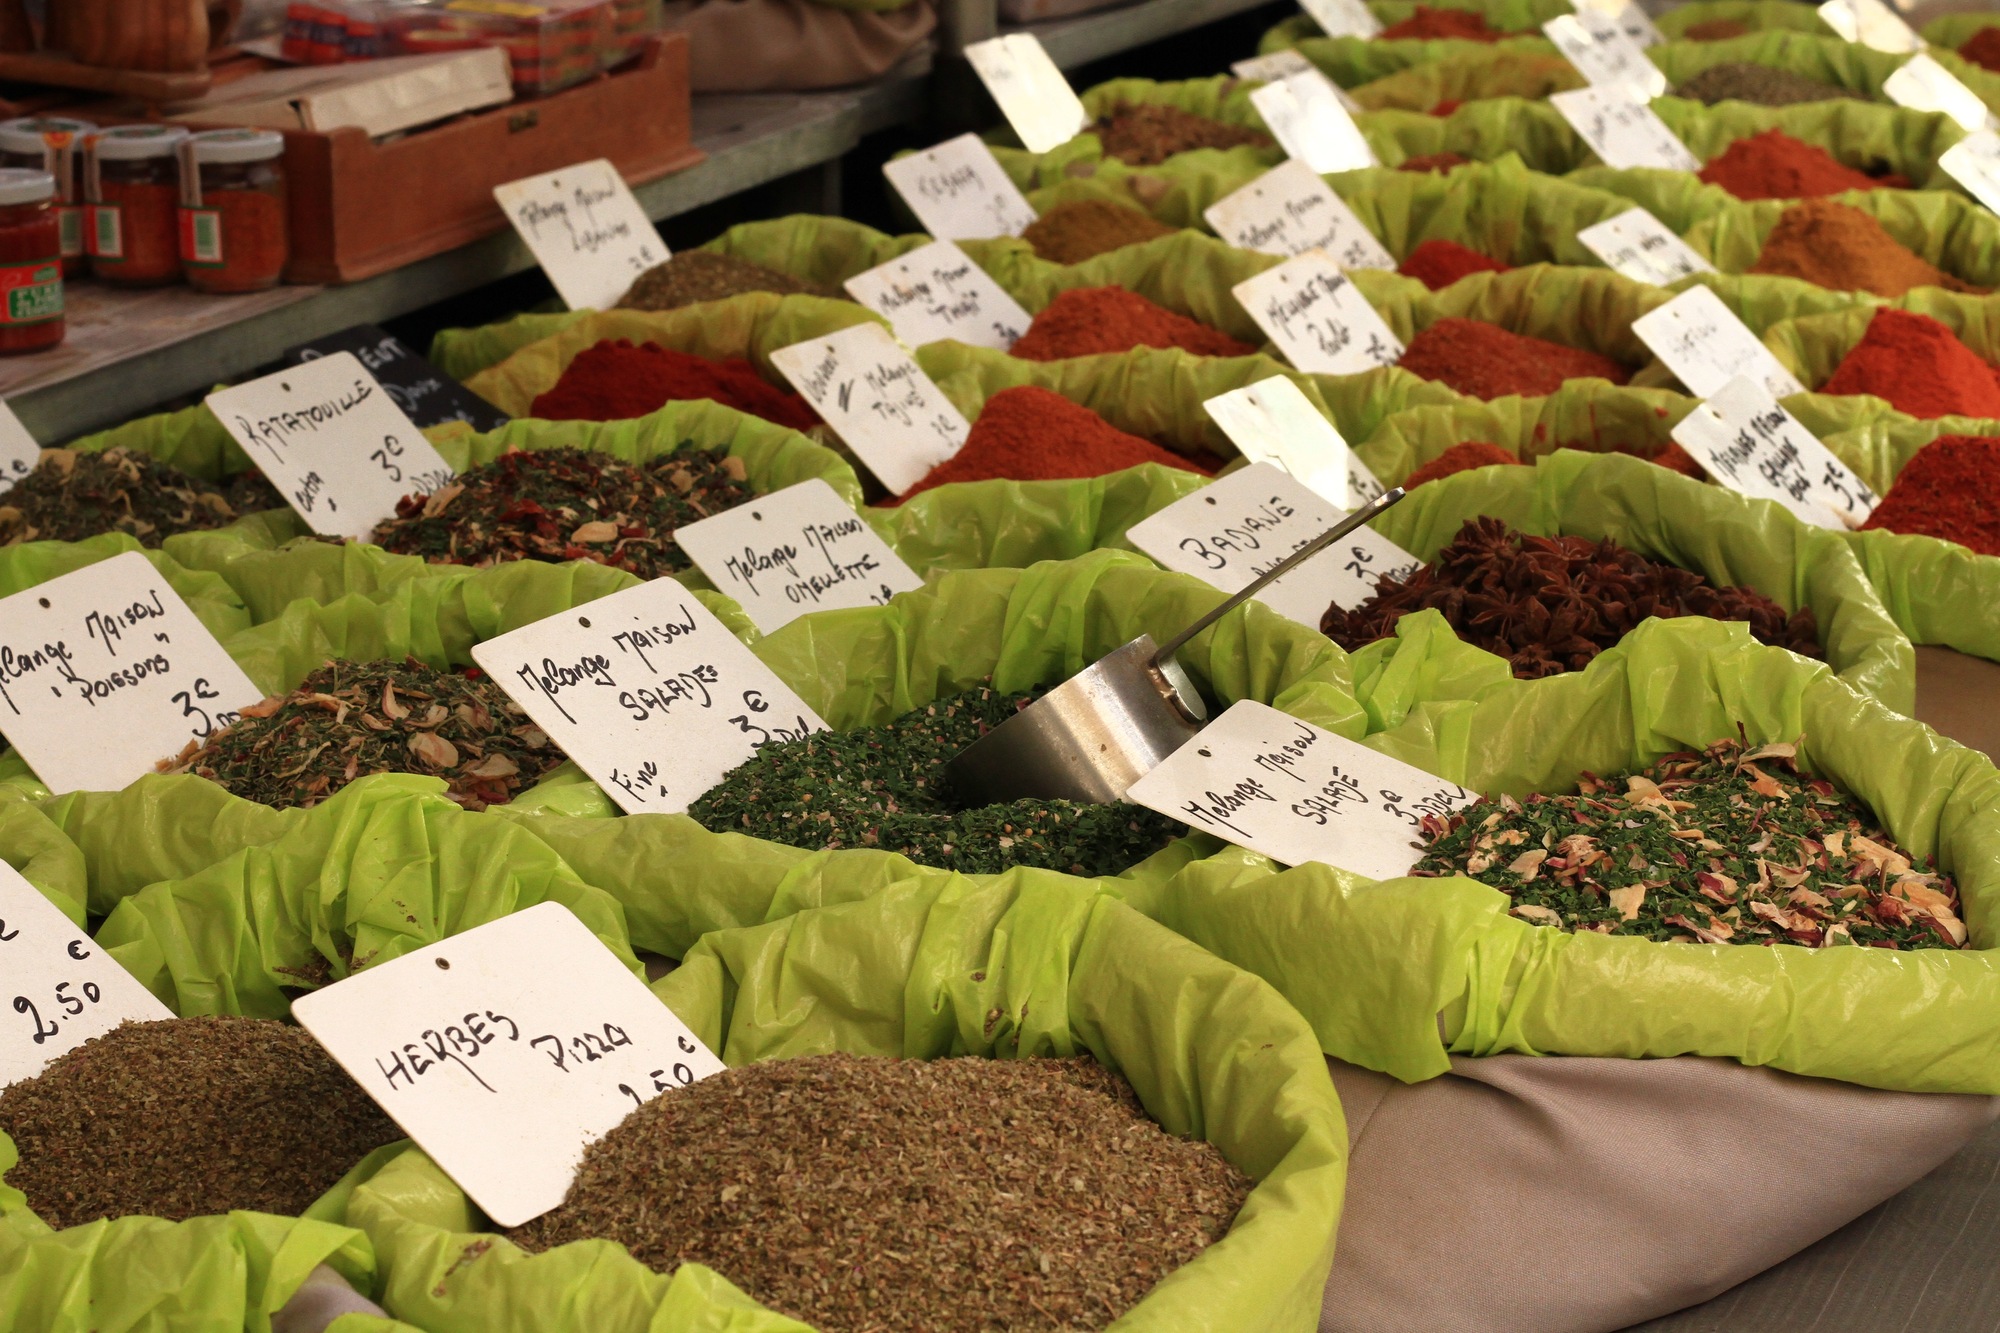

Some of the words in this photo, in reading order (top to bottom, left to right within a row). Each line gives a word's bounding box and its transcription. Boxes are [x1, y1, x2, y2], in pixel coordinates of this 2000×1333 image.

[235, 379, 373, 465] RATATOUILLE
[1178, 495, 1295, 570] BADIANE
[723, 544, 800, 597] Melange
[0, 641, 77, 716] elange
[516, 653, 617, 725] Melange
[618, 663, 719, 722] SALADES
[608, 760, 658, 803] Fine
[1181, 776, 1279, 839] Melange
[1291, 764, 1370, 826] SALADE
[375, 1010, 520, 1094] HERBES
